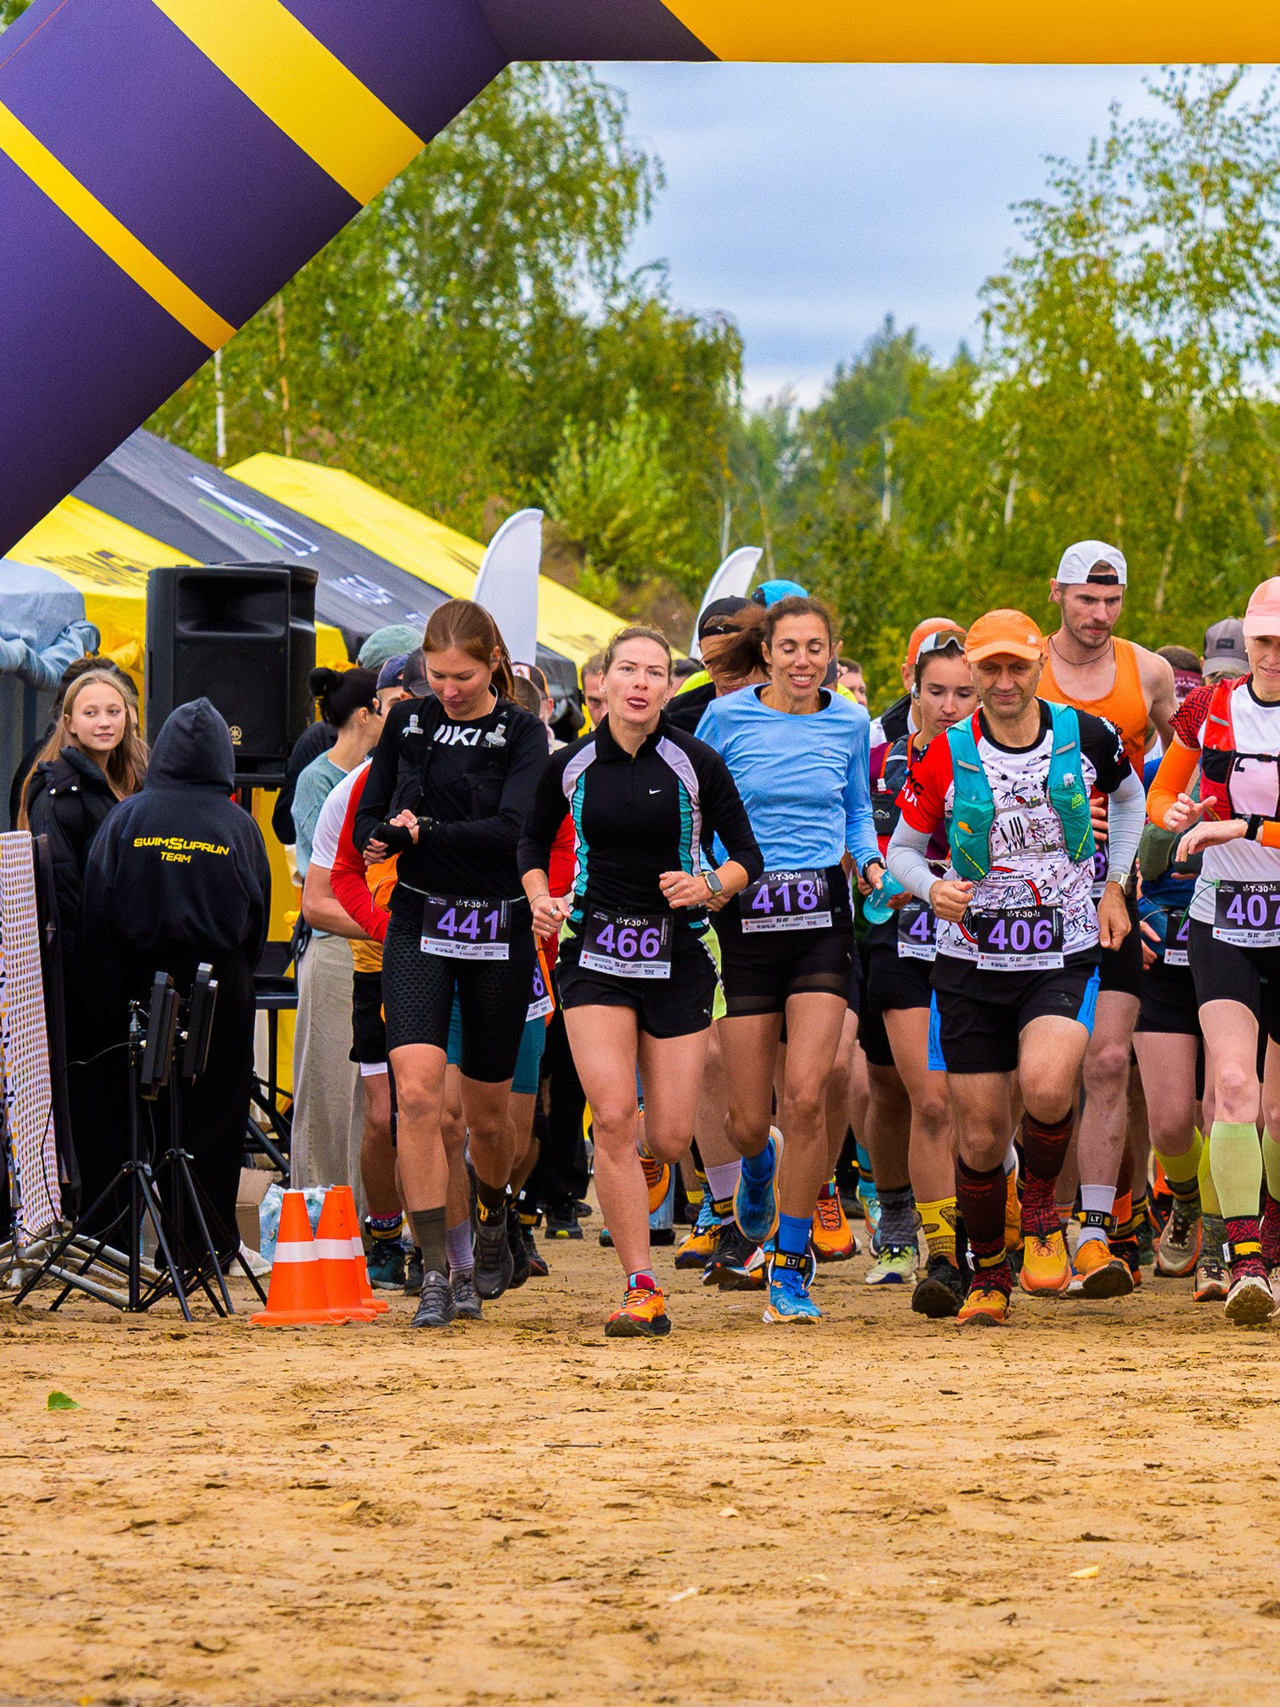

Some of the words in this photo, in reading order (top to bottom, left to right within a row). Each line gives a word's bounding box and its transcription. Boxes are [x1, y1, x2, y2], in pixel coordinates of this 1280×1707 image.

[161, 851, 192, 864] TEAM
[751, 880, 818, 914] 418
[437, 907, 499, 940] 441
[987, 919, 1053, 952] 406
[595, 923, 660, 959] 466
[787, 1258, 796, 1266] LT
